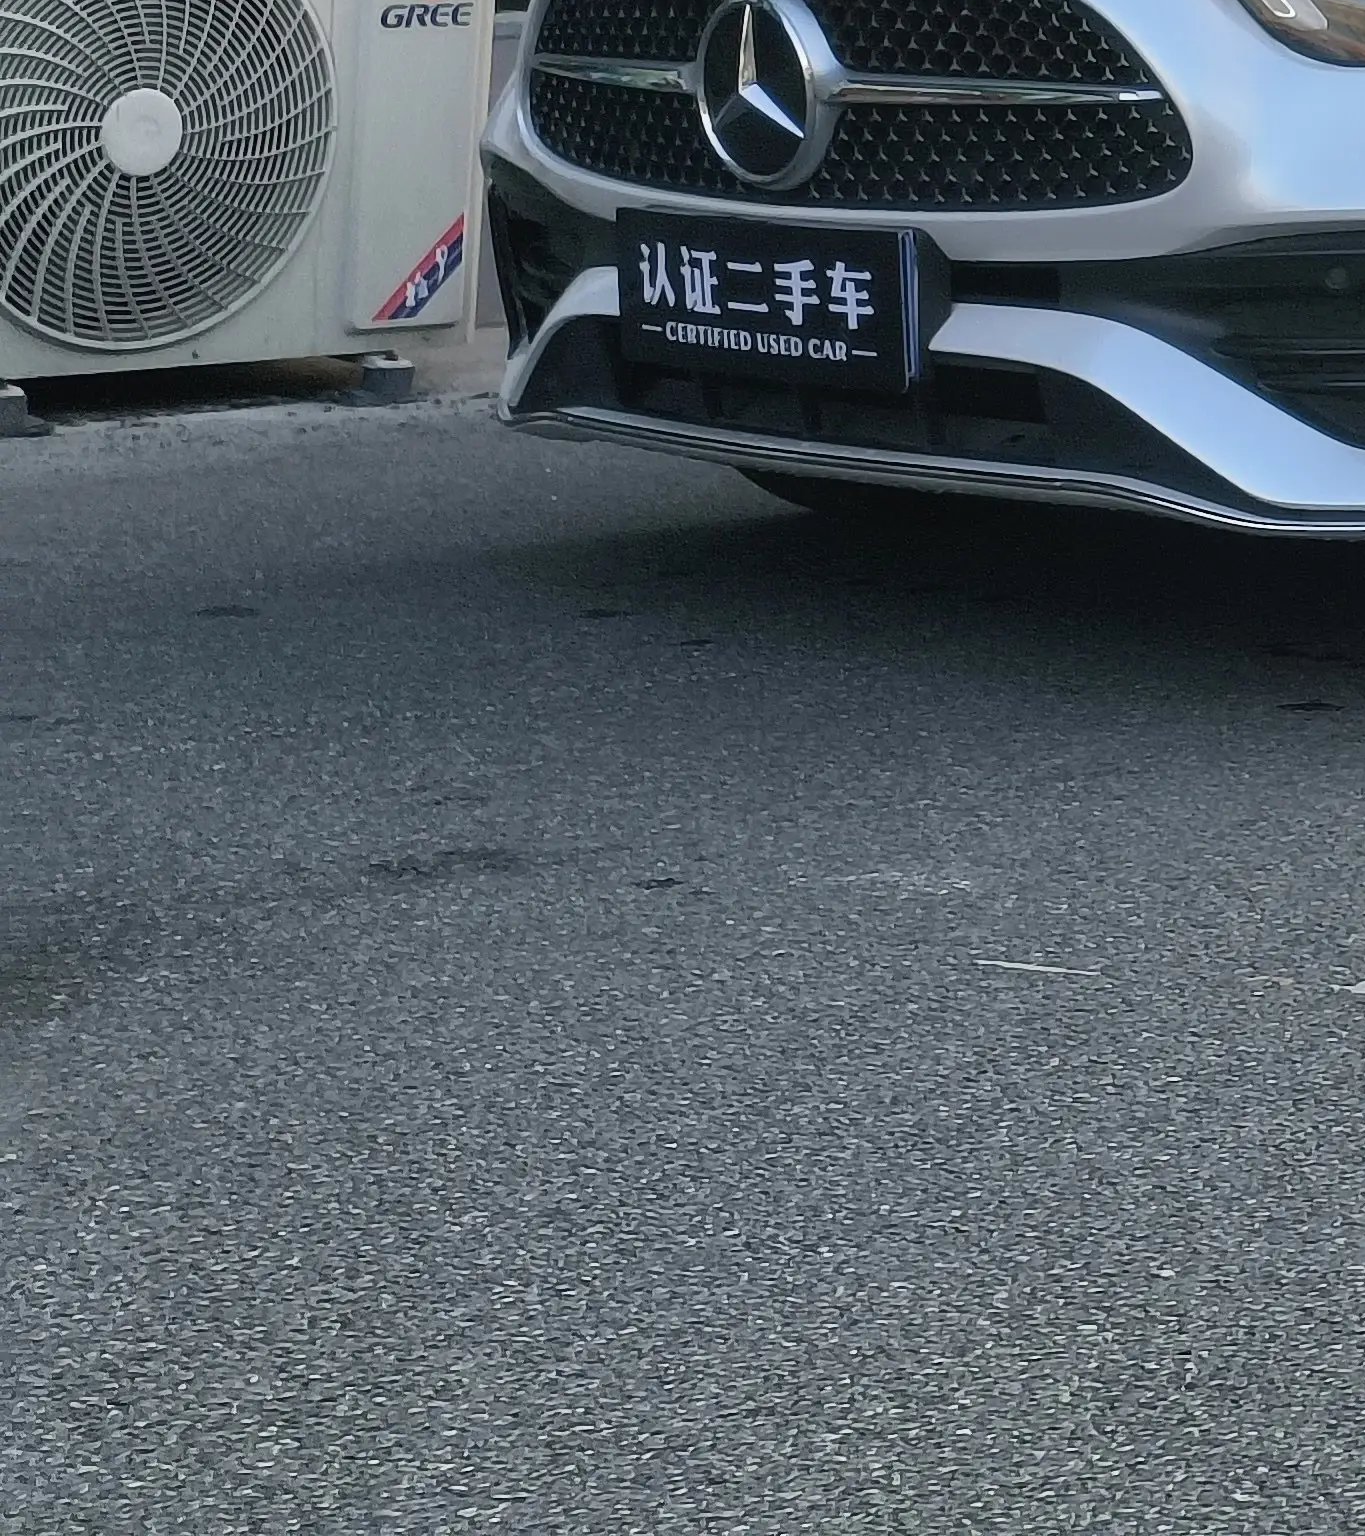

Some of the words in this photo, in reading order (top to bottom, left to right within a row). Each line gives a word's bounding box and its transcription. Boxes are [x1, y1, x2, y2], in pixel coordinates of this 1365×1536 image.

[380, 2, 474, 29] GREE
[638, 241, 875, 330] 认证二手车
[665, 321, 751, 352] CERTIFIED
[756, 332, 802, 357] USED
[808, 338, 848, 362] CAR
